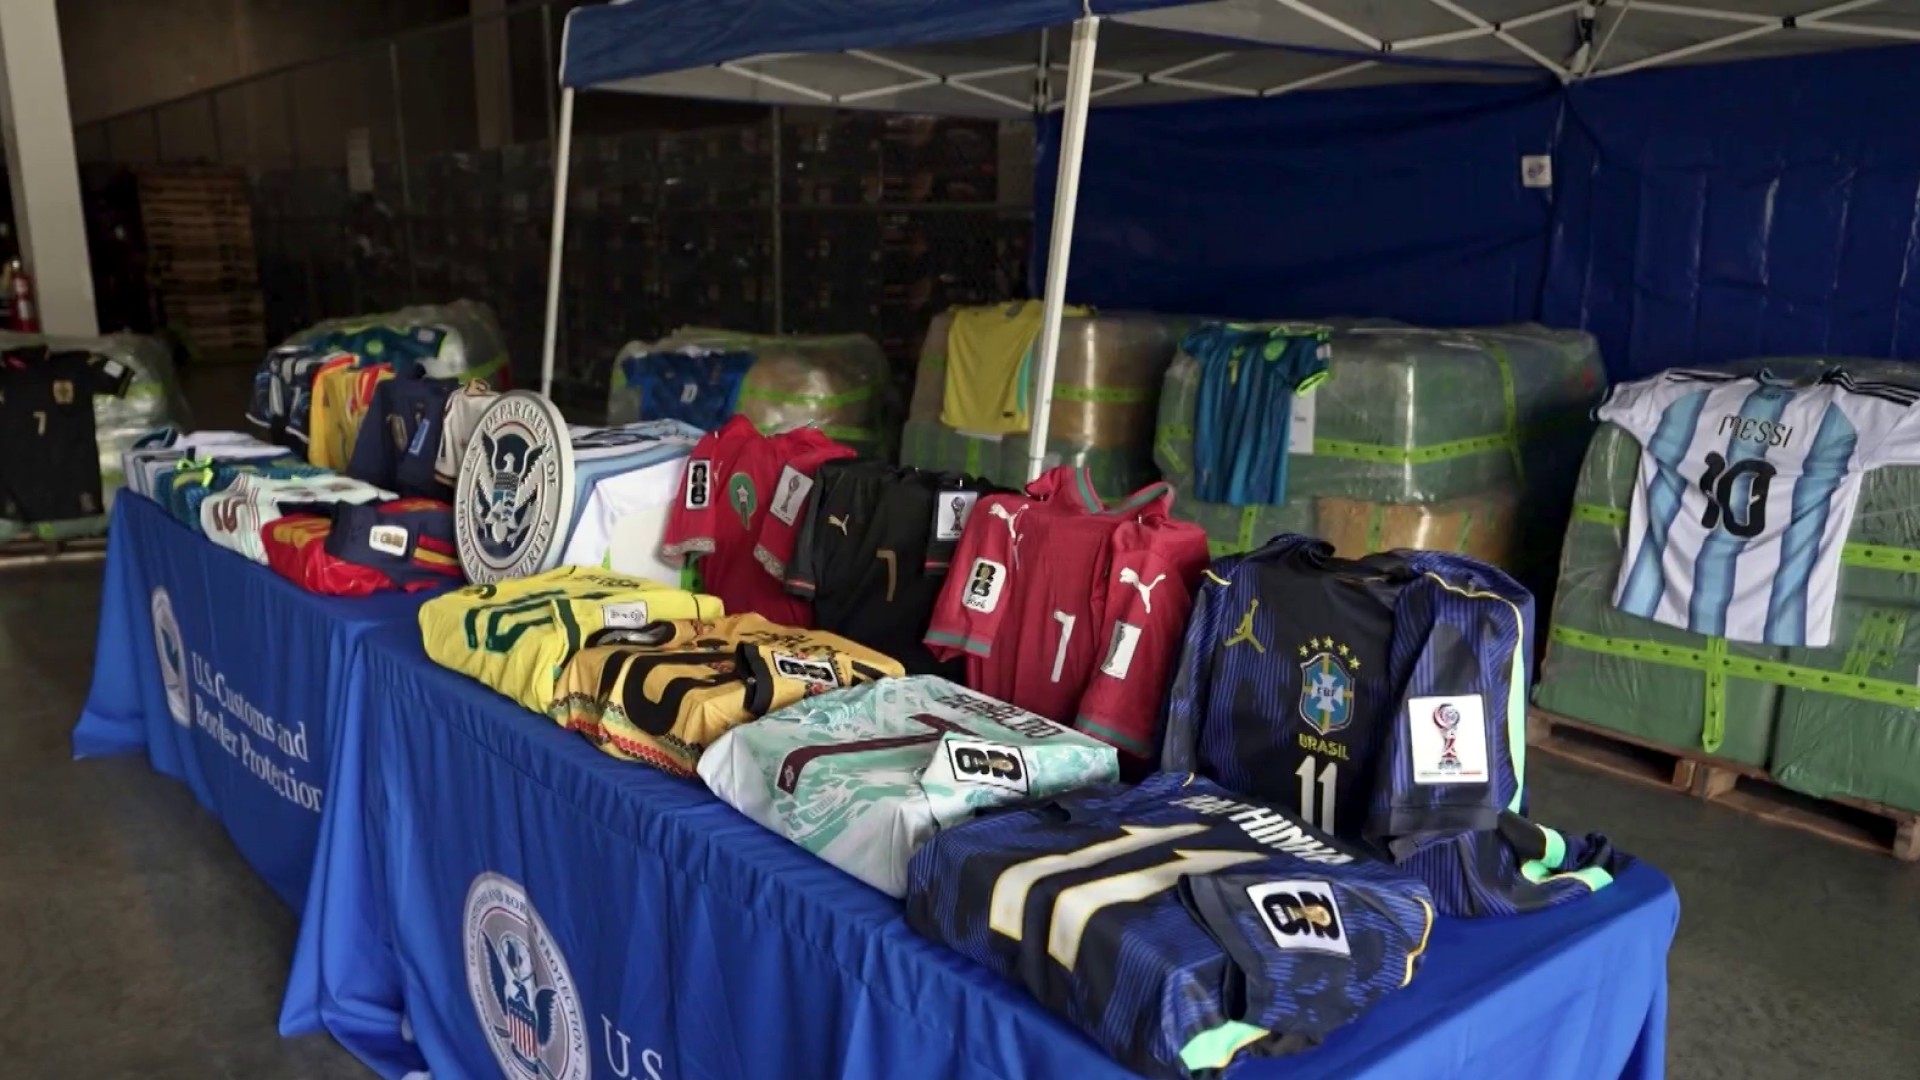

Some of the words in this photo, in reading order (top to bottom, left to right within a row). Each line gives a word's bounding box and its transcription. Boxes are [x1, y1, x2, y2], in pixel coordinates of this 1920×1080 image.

[33, 410, 47, 435] 7
[484, 400, 556, 455] DEPARTMENT
[547, 461, 558, 488] OF
[1718, 413, 1794, 448] MESSI
[1699, 450, 1778, 538] 10
[875, 549, 898, 602] 7
[1051, 610, 1077, 683] 7
[195, 693, 239, 758] Border
[214, 672, 276, 742] Customs
[277, 718, 310, 763] and
[1298, 733, 1350, 761] BRASIL
[1295, 755, 1338, 836] 11
[989, 822, 1270, 974] 11
[540, 937, 584, 1059] PROTECTION
